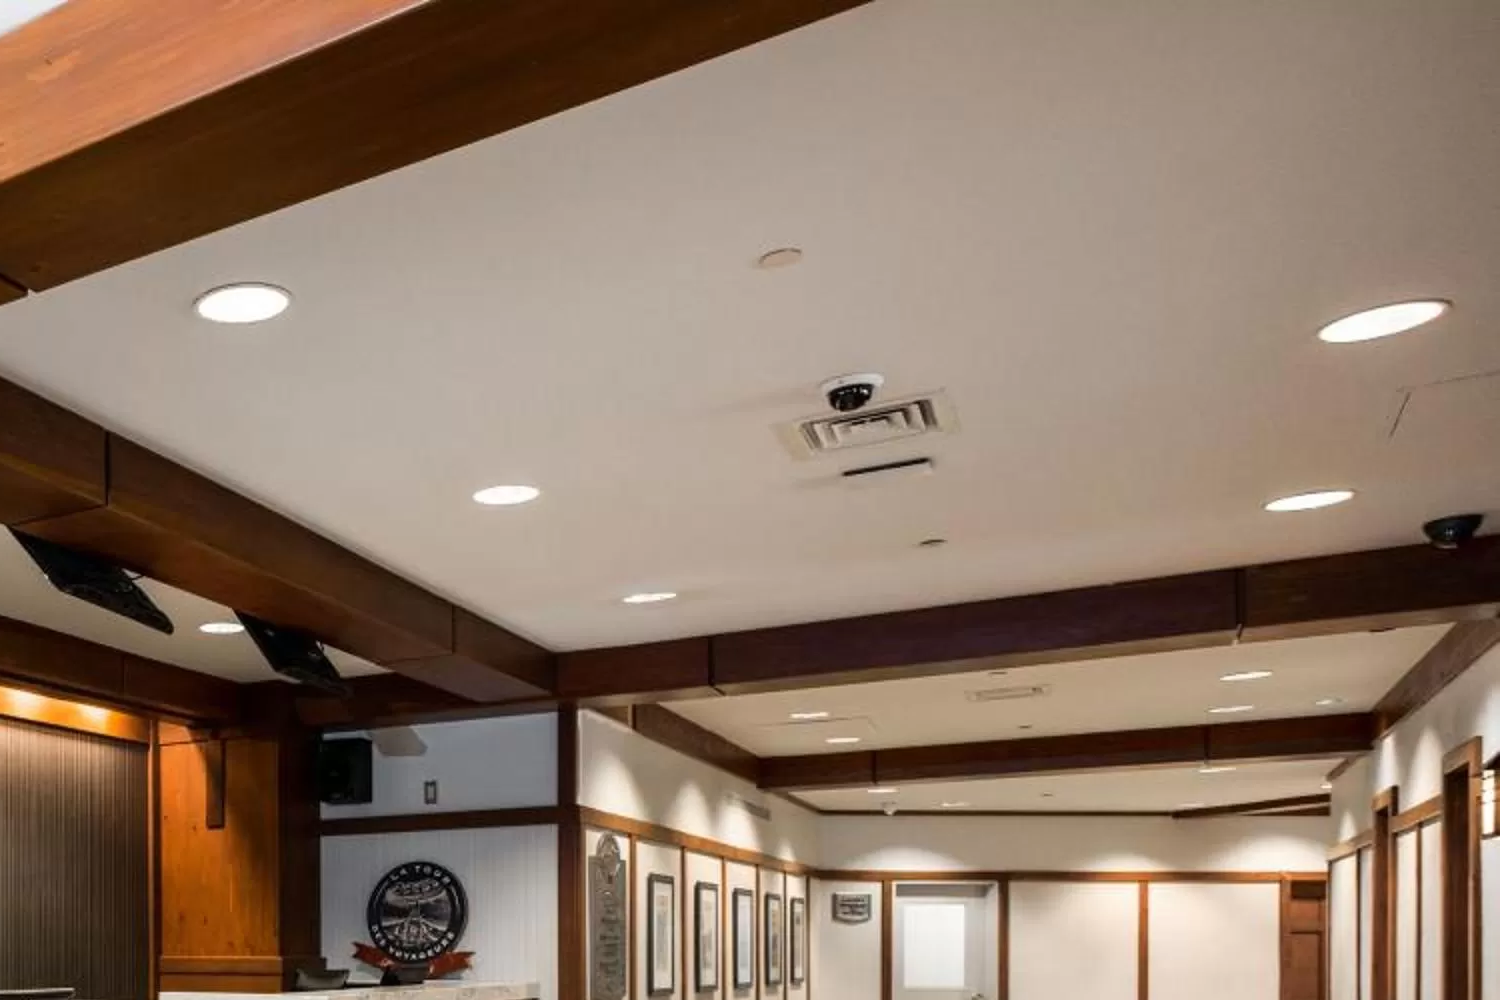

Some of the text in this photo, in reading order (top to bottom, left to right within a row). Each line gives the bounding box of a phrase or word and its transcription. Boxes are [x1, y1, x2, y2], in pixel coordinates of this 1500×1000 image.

[390, 865, 451, 883] LA TOUR
[371, 924, 386, 945] DES
